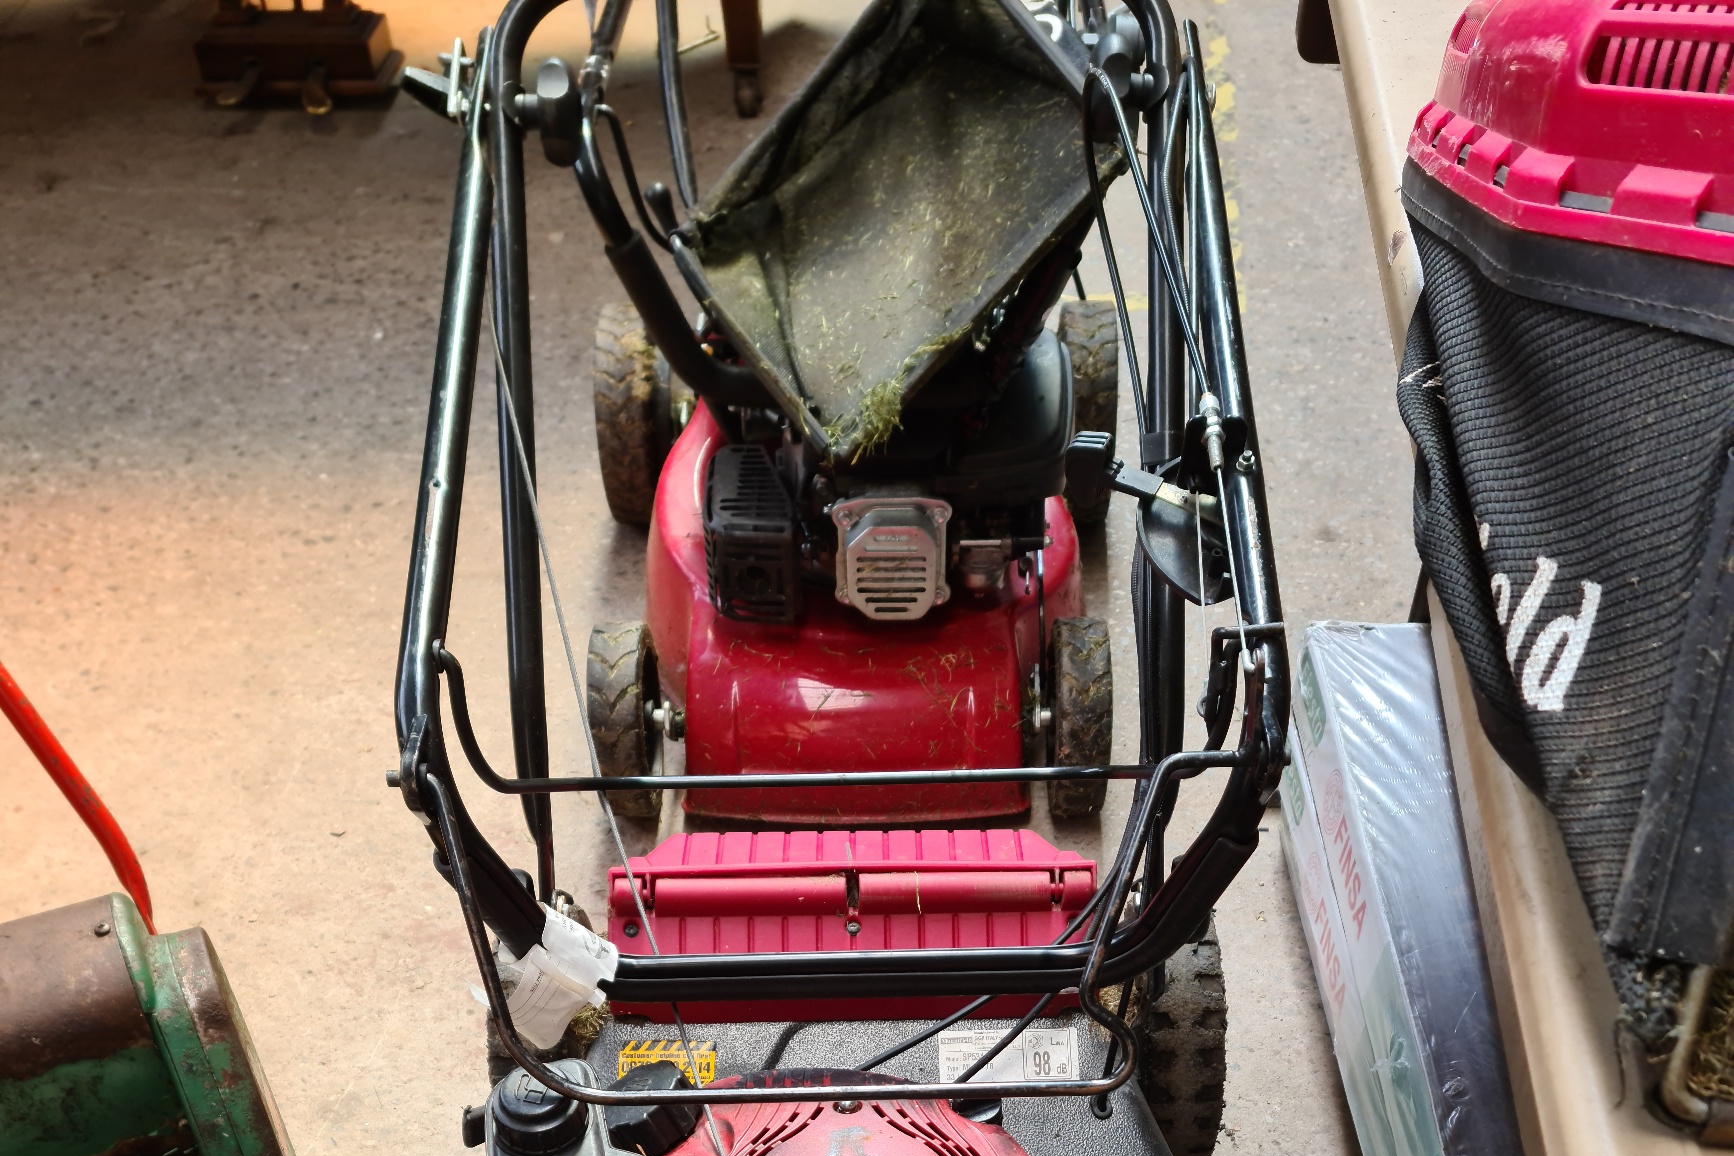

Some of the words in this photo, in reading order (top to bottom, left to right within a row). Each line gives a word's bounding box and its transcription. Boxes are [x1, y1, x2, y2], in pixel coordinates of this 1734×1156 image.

[1334, 814, 1367, 942] FINSA
[1314, 896, 1346, 1017] FINSA
[1033, 1051, 1051, 1075] 98
[1057, 1063, 1068, 1074] dB
